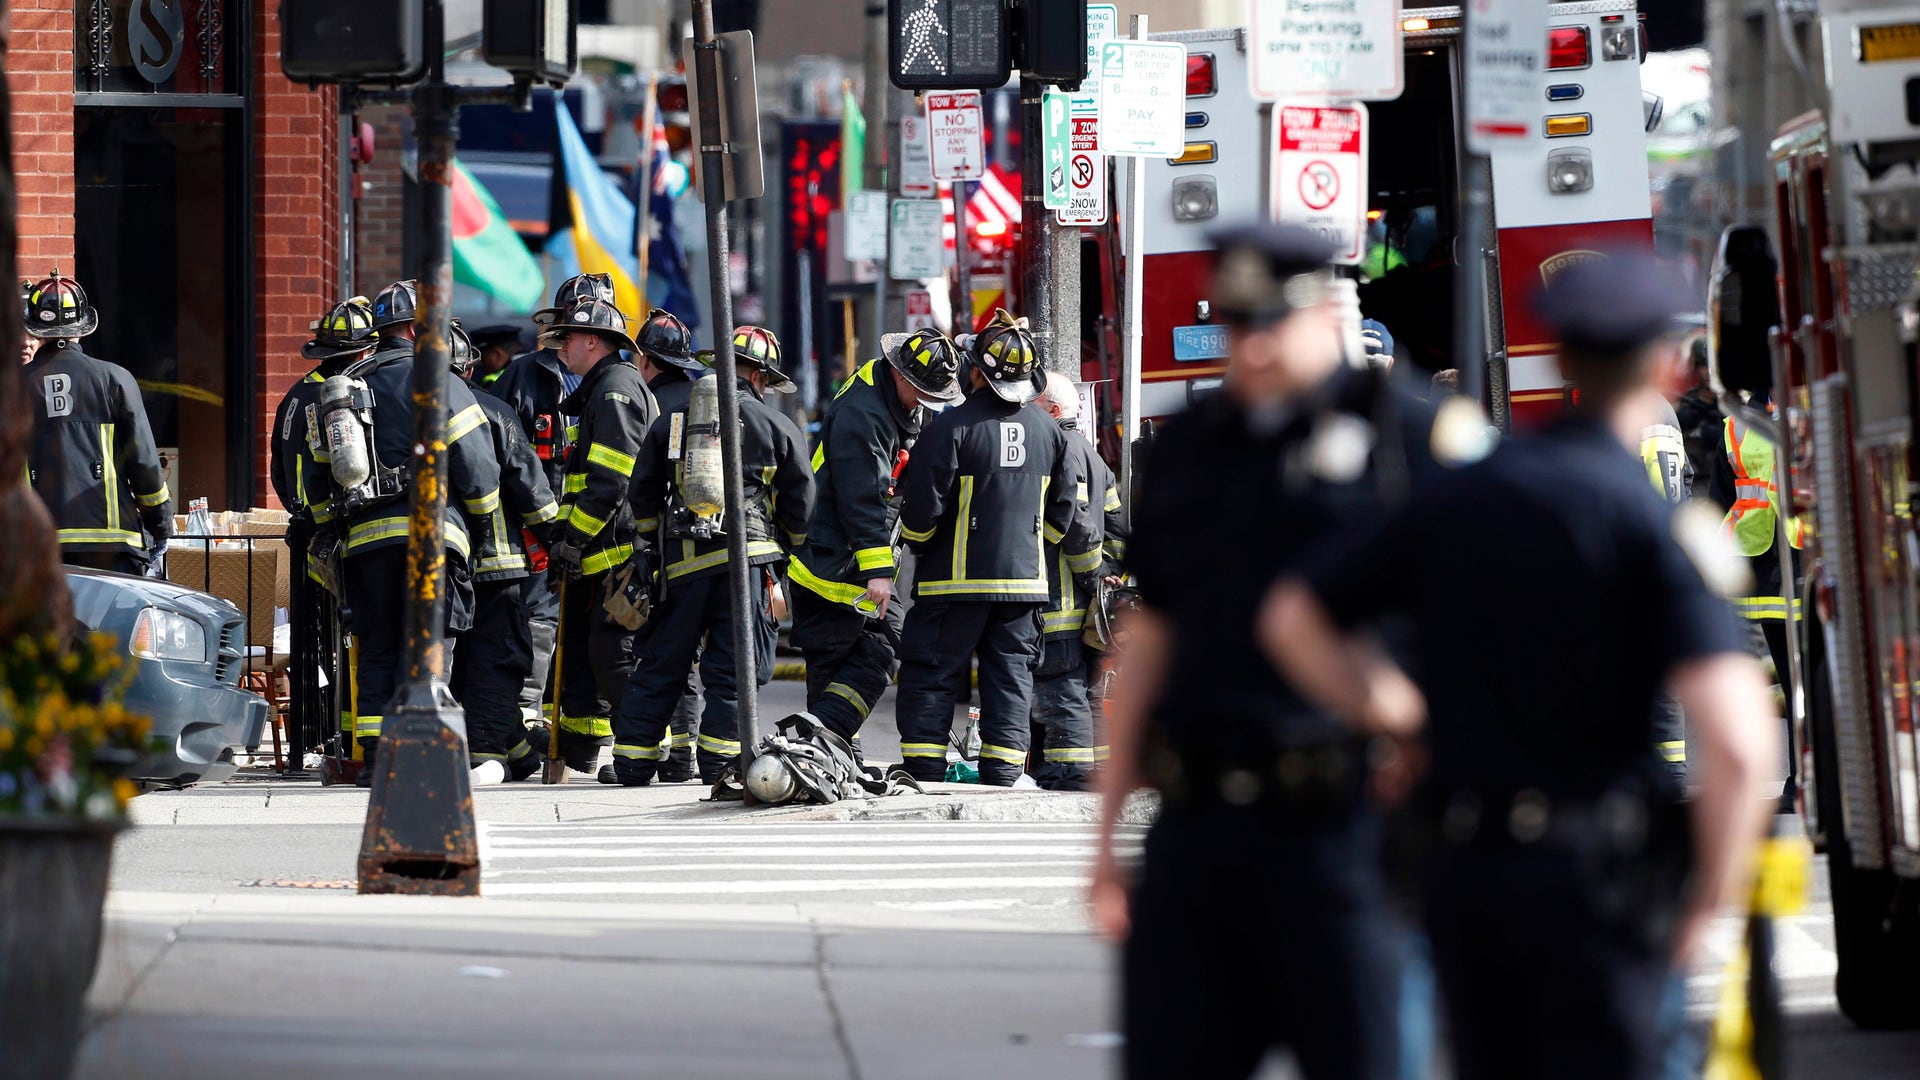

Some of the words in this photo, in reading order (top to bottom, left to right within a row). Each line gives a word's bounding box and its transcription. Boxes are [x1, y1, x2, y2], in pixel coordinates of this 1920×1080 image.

[1280, 18, 1363, 37] Parking
[1105, 45, 1123, 68] 2
[1129, 50, 1177, 60] PARKING
[1135, 61, 1170, 70] METER
[1139, 72, 1167, 80] LIMIT
[930, 97, 950, 107] TOW
[1128, 109, 1155, 120] PAY
[946, 114, 965, 126] NO
[935, 127, 977, 136] STOPPING
[1070, 198, 1097, 208] SNOW
[1065, 209, 1100, 217] EMERGENCY
[376, 304, 385, 316] 2
[1201, 334, 1231, 350] 890
